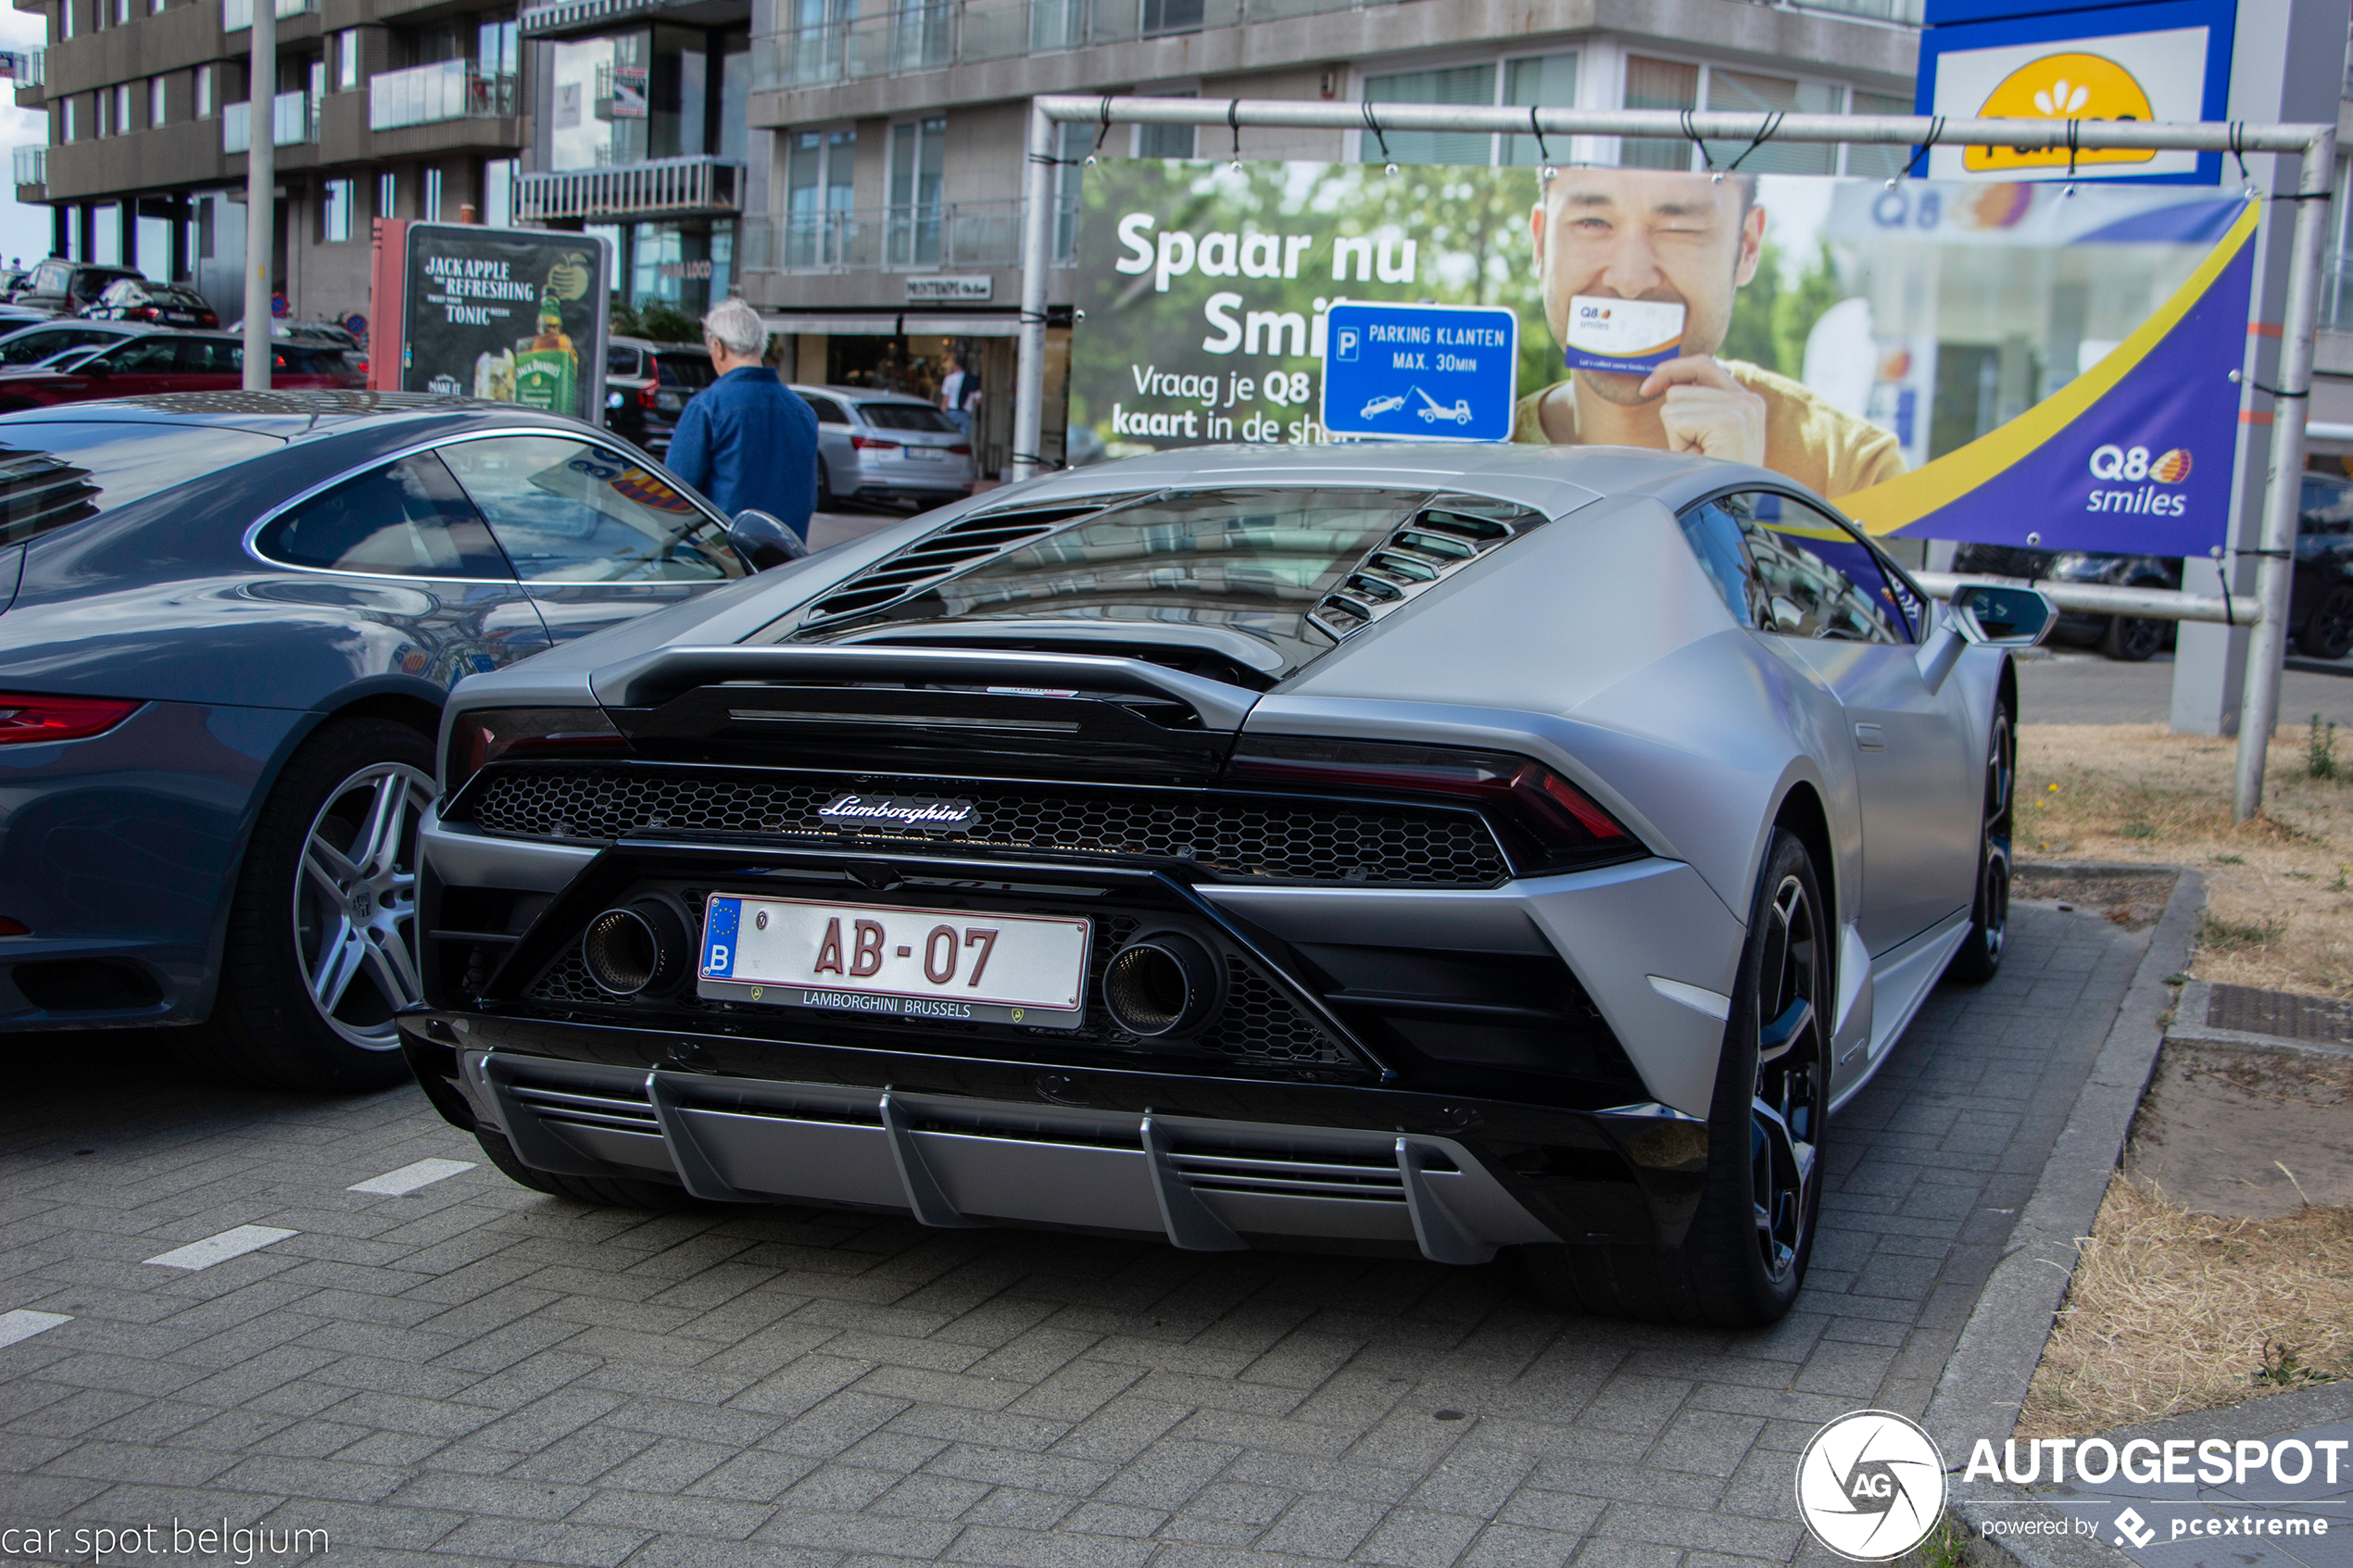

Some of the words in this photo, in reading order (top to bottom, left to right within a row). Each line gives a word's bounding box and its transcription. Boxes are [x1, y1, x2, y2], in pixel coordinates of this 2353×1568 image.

[1114, 212, 1313, 293] Spaar
[1331, 236, 1417, 283] nu
[424, 256, 463, 277] JACK
[464, 258, 510, 281] APPLE
[686, 259, 711, 279] LOCO
[446, 277, 535, 302] REFRESHING
[446, 304, 491, 326] TONIC
[1202, 292, 1348, 358] Smi
[1579, 320, 1609, 331] smiles
[1580, 306, 1599, 319] Q8
[1340, 332, 1356, 357] P
[1369, 324, 1431, 345] PARKING
[1436, 327, 1504, 347] KLANTEN
[1392, 351, 1429, 370] MAX.
[1131, 364, 1219, 407] Vraag
[1223, 370, 1255, 408] je
[1262, 370, 1311, 408] Q8
[1112, 403, 1199, 439] kaart
[1207, 410, 1233, 440] in
[1242, 411, 1280, 443] de
[1287, 413, 1360, 445] sh
[2088, 444, 2150, 482] Q8
[2086, 484, 2187, 517] smiles
[819, 795, 970, 823] Lamborghini
[710, 945, 729, 971] B
[813, 917, 999, 987] AB-07
[803, 991, 899, 1011] LAMBORGHINI
[904, 999, 972, 1019] BRUSSELS
